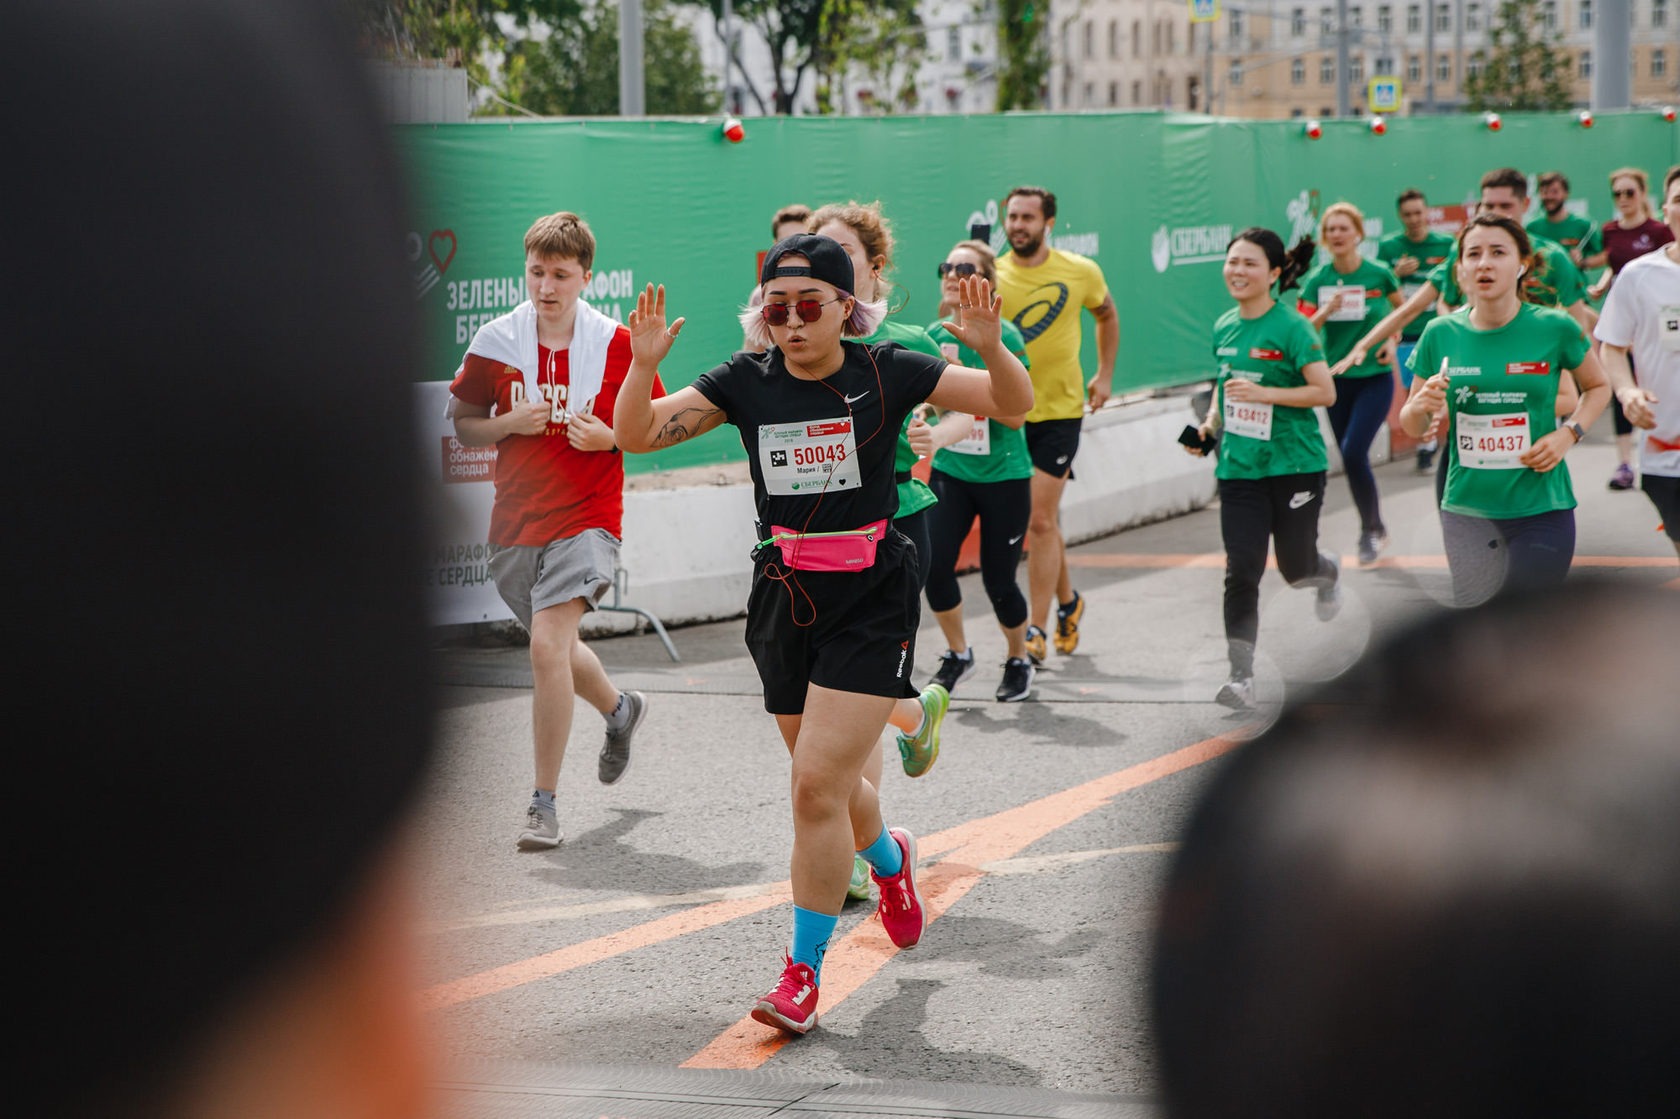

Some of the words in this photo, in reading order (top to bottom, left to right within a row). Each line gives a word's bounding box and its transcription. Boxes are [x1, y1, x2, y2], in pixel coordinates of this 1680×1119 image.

[447, 277, 528, 310] ЗЕЛЕНЫ
[582, 269, 633, 300] АФОН
[794, 444, 846, 466] 50043
[1478, 435, 1524, 452] 40437
[896, 649, 907, 678] Reebok
